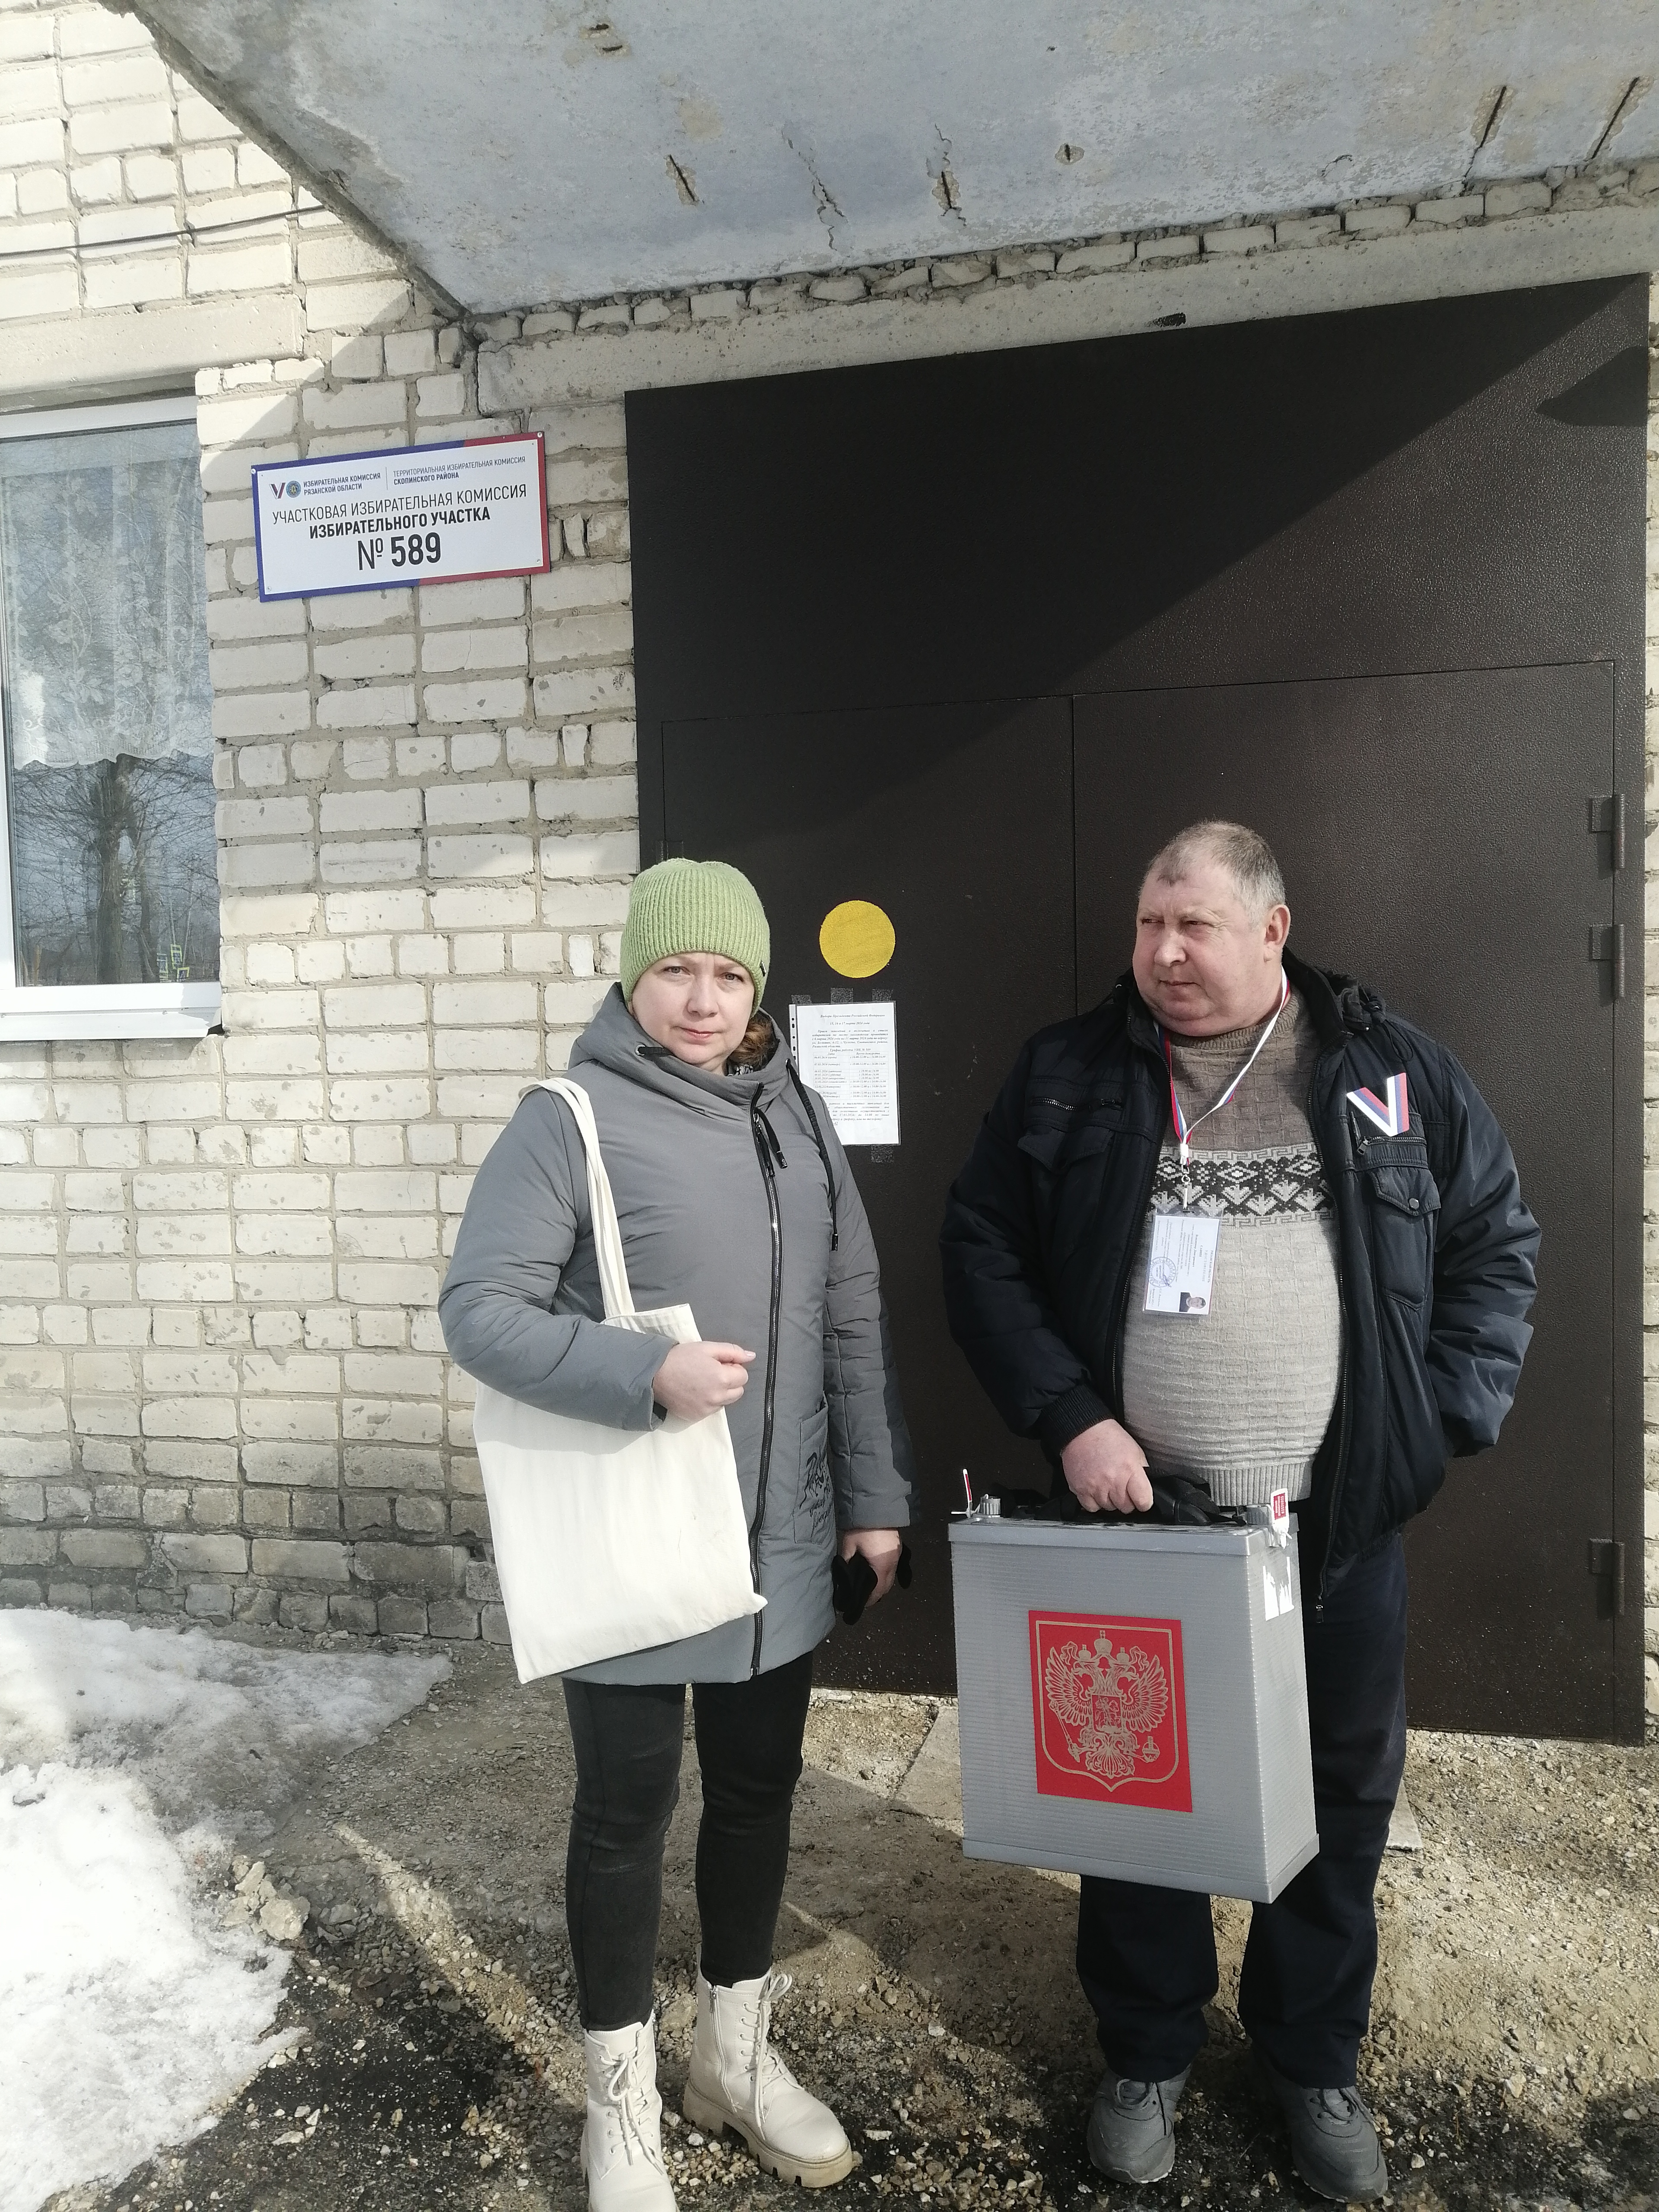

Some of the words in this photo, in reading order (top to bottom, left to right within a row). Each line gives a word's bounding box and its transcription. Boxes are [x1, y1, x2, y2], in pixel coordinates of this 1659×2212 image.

[393, 465, 445, 477] ТЕРРИТОРИАЛЬНАЯ
[447, 460, 493, 471] ИЗБИРАТЕЛЬНАЯ
[494, 456, 525, 466] КОМИССИЯ
[303, 477, 349, 488] ИЗБИРАТЕЛЬНАЯ
[350, 473, 381, 482] КОМИССИЯ
[394, 474, 435, 485] СКОПИНСКОГО
[436, 472, 459, 480] РАЙОНА
[304, 485, 336, 496] РЯЗАНСКОЙ
[337, 483, 362, 492] ОБЛАСТИ
[272, 504, 347, 525] УЧАСТКОВАЯ
[351, 492, 452, 516] ИЗБИРАТЕЛЬНАЯ
[457, 484, 526, 504] КОМИССИЯ
[309, 513, 427, 539] ИЗБИРАТЕЛЬНОГО
[430, 506, 490, 526] УЧАСТКА
[358, 538, 383, 571] №
[391, 532, 441, 567] 589
